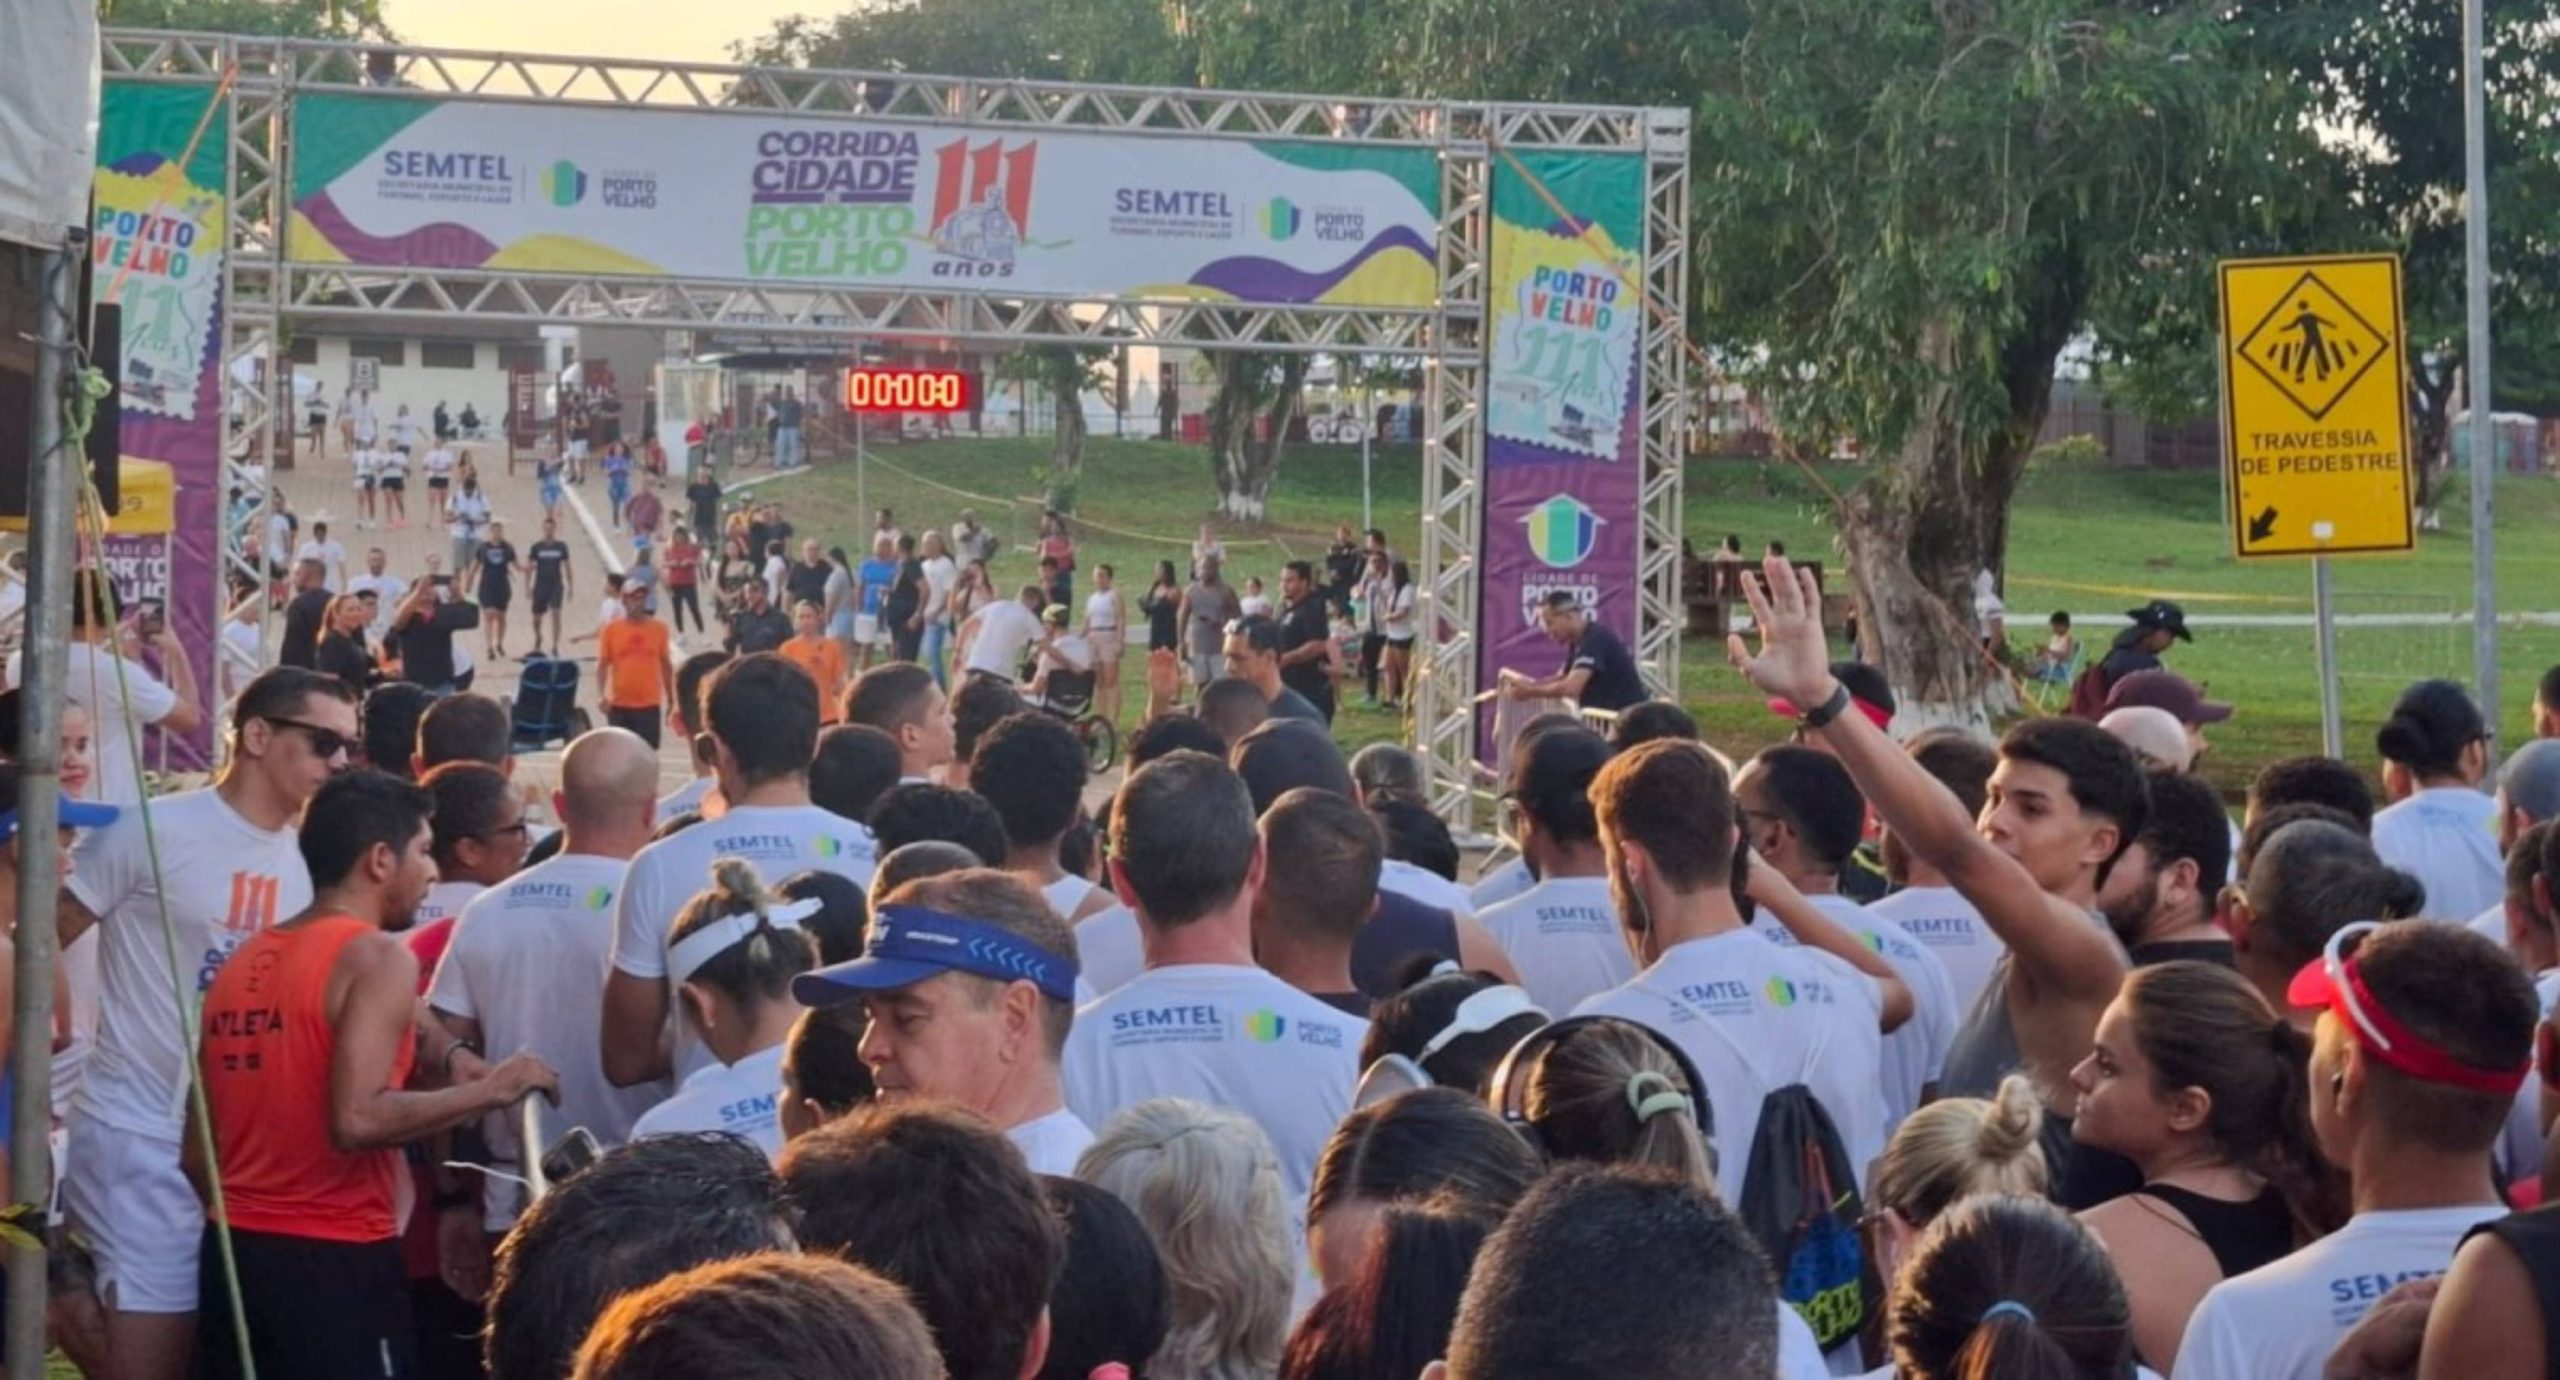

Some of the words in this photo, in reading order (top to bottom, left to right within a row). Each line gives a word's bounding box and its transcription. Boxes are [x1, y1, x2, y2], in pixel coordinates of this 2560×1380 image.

[758, 131, 919, 157] CORRIDA
[384, 150, 512, 182] SEMTEL
[603, 177, 657, 193] PORTO
[929, 136, 1038, 245] 111
[603, 192, 657, 209] VELHO
[1115, 188, 1233, 218] SEMTEL
[96, 204, 195, 248] PORTO
[746, 205, 915, 239] PORTO
[1315, 212, 1364, 227] PORTO
[1315, 226, 1364, 242] VELHO
[93, 235, 190, 279] VELHO
[744, 240, 908, 277] VELHO
[932, 259, 1016, 278] anos
[1533, 264, 1618, 304] PORTO
[1531, 292, 1612, 332] VELHO
[1507, 326, 1602, 394] 111
[2251, 429, 2378, 450] TRAVESSIA
[2240, 456, 2271, 476] DE
[2277, 452, 2399, 474] PEDESTRE
[713, 834, 795, 852] SEMTEL
[509, 883, 572, 897] SEMTEL
[1901, 918, 1974, 934] SEMTEL
[209, 1008, 283, 1037] ATLETA
[1112, 1004, 1223, 1031] SEMTEL
[719, 1093, 776, 1122] SEM
